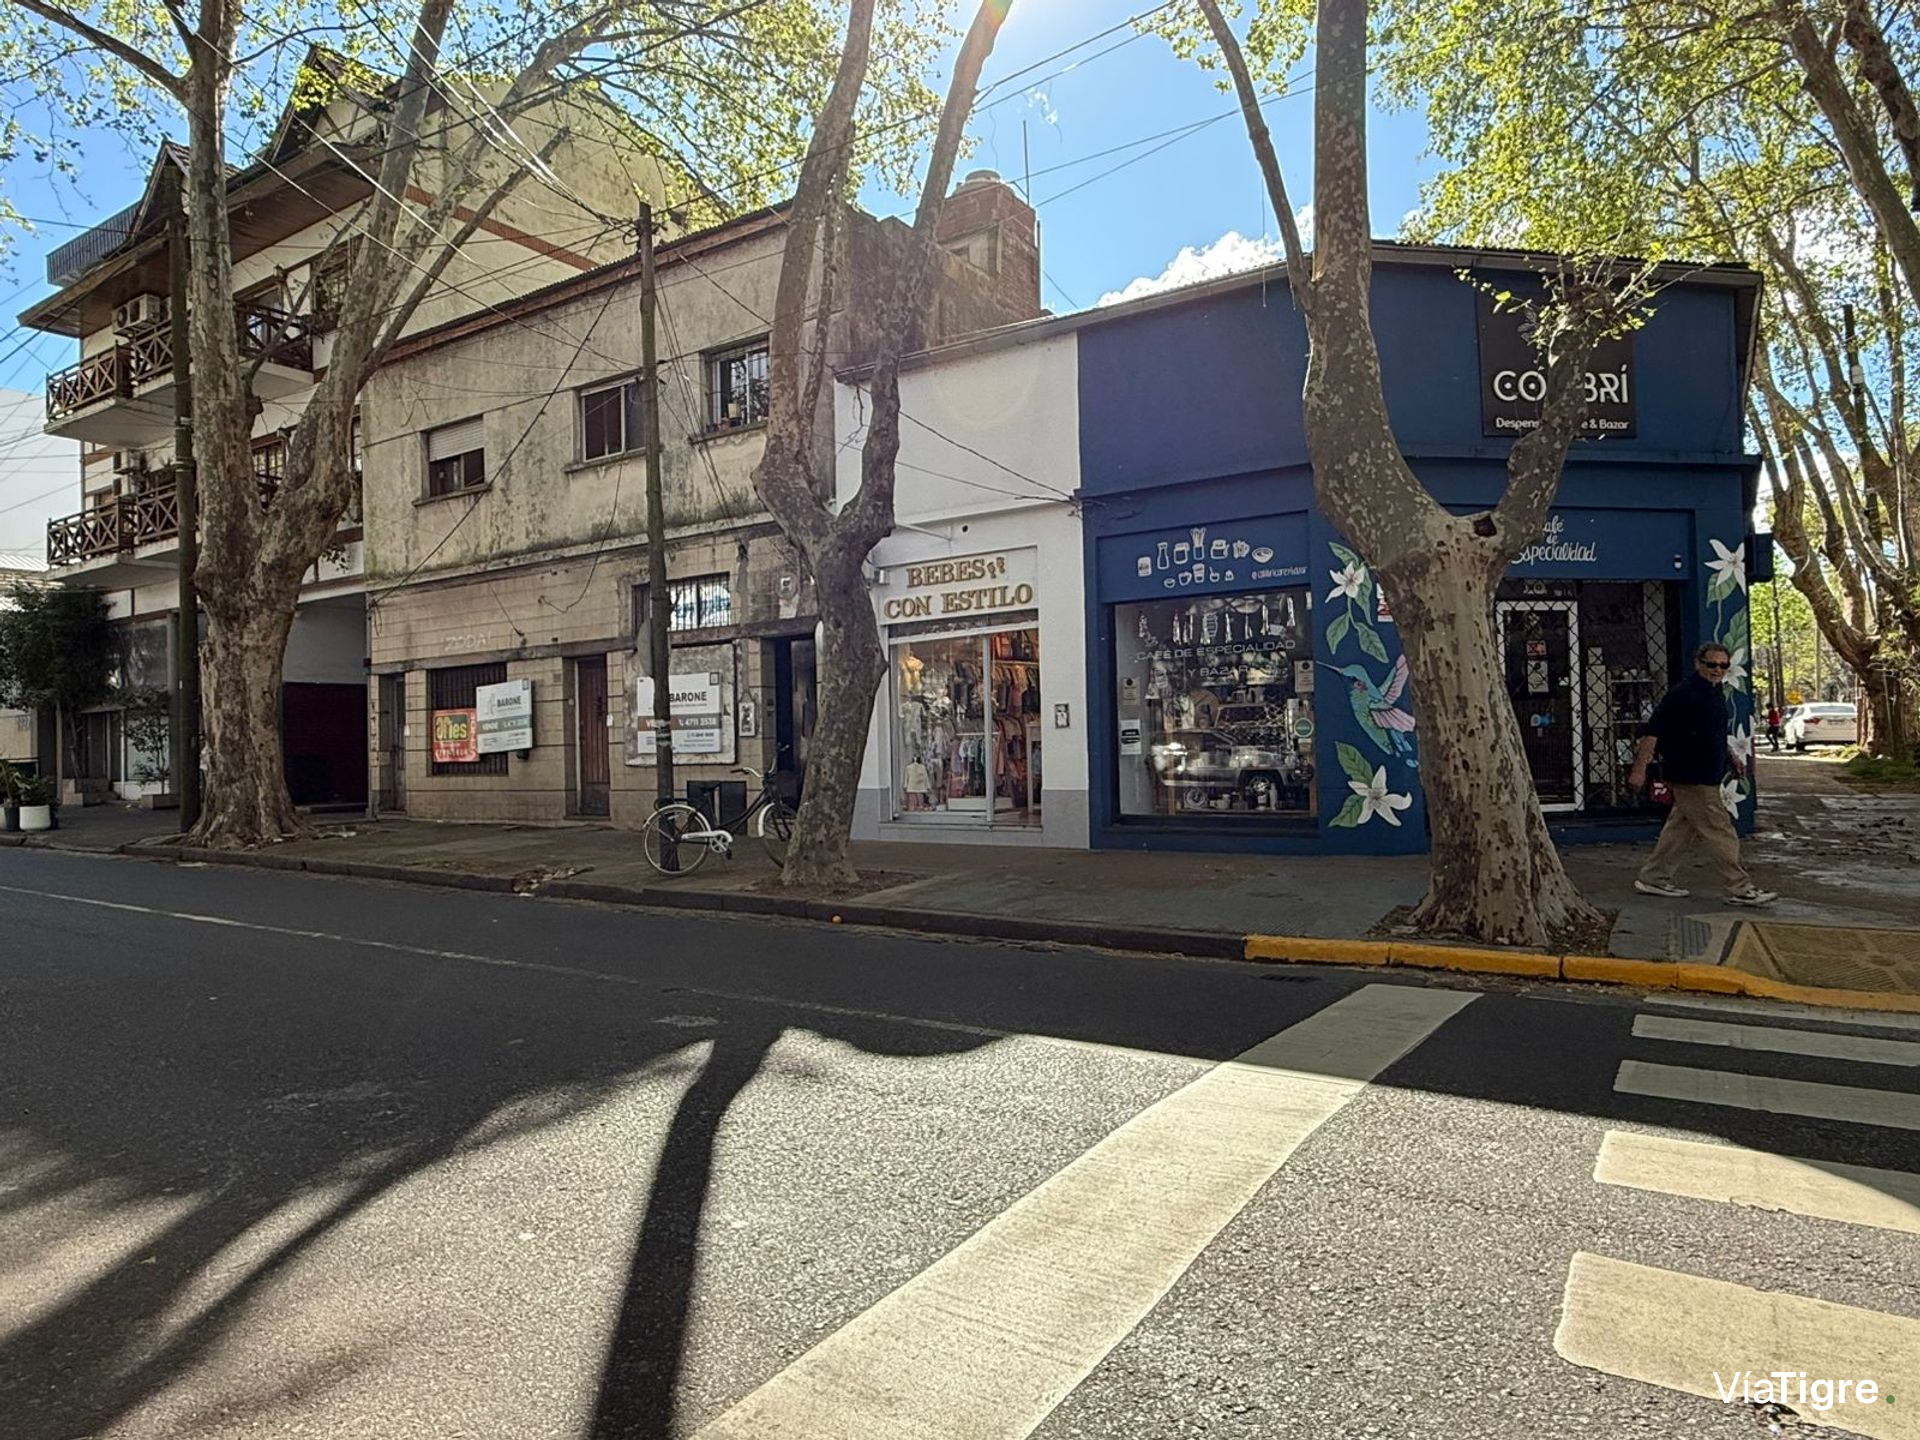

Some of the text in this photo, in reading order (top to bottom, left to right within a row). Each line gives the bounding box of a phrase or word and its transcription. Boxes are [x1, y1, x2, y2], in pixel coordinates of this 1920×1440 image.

[1496, 417, 1541, 430] Despens
[1599, 418, 1629, 429] Bazar
[1543, 515, 1564, 534] afé
[906, 558, 985, 588] BEBES
[884, 583, 1033, 619] CON ESTILO
[1174, 648, 1193, 659] DE
[1196, 639, 1295, 658] ESPECIALIDAD
[669, 691, 707, 702] BARONE
